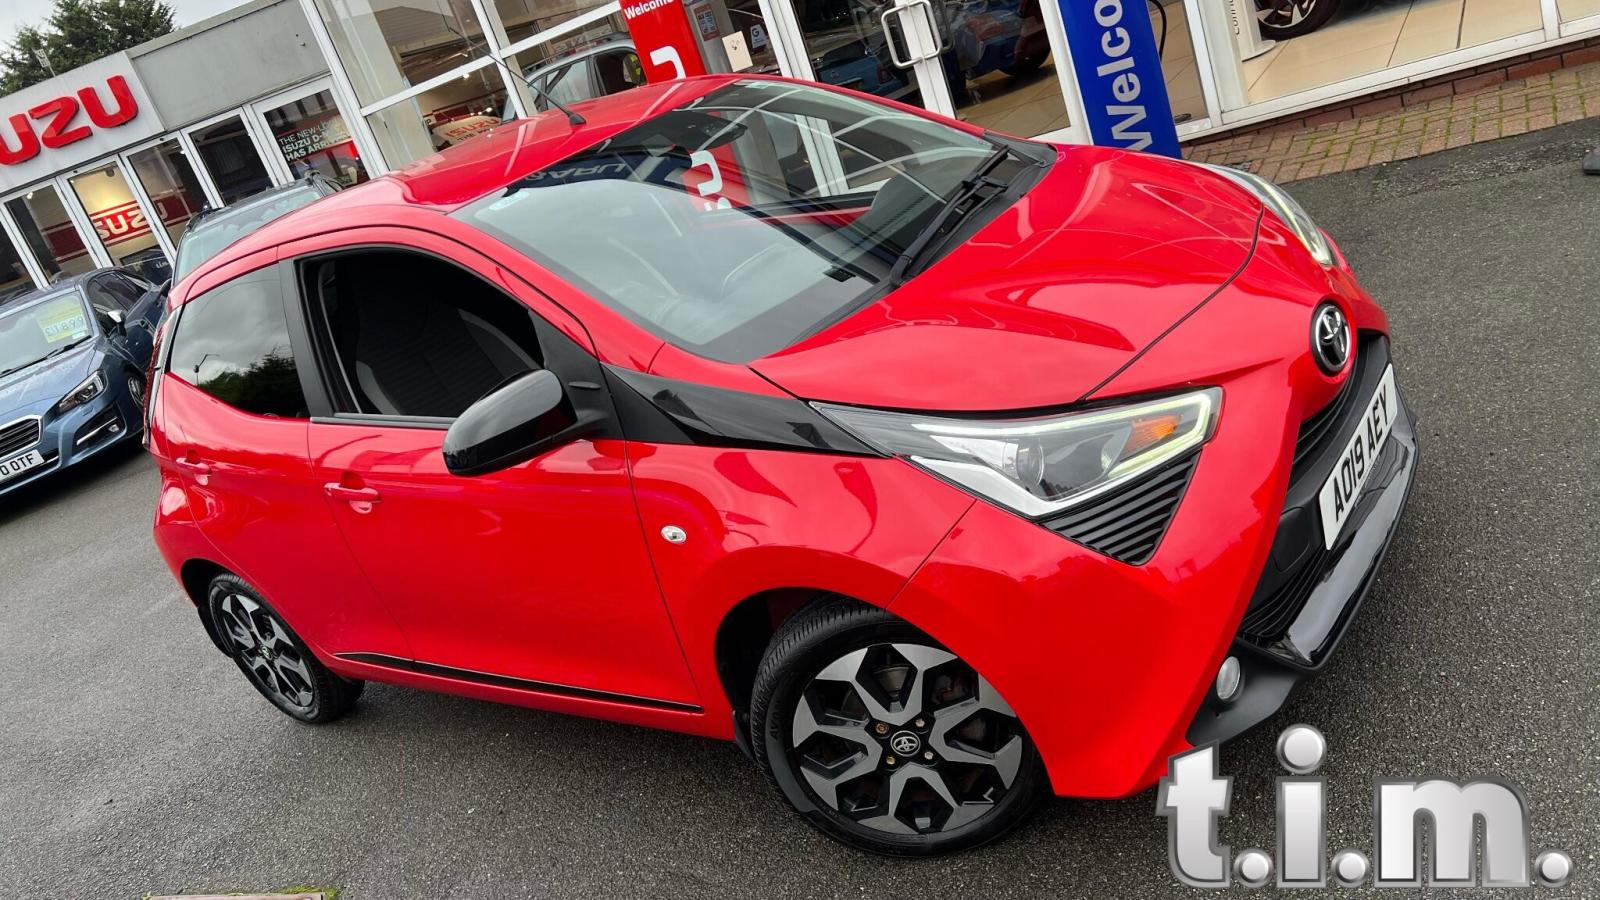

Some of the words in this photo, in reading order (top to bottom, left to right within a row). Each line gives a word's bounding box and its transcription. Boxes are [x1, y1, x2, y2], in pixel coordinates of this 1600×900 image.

[279, 135, 296, 146] THE
[282, 138, 311, 153] ISUZU
[285, 148, 306, 161] HAS
[1333, 434, 1365, 522] AO19
[1366, 384, 1388, 460] AEY
[10, 453, 34, 471] OTF
